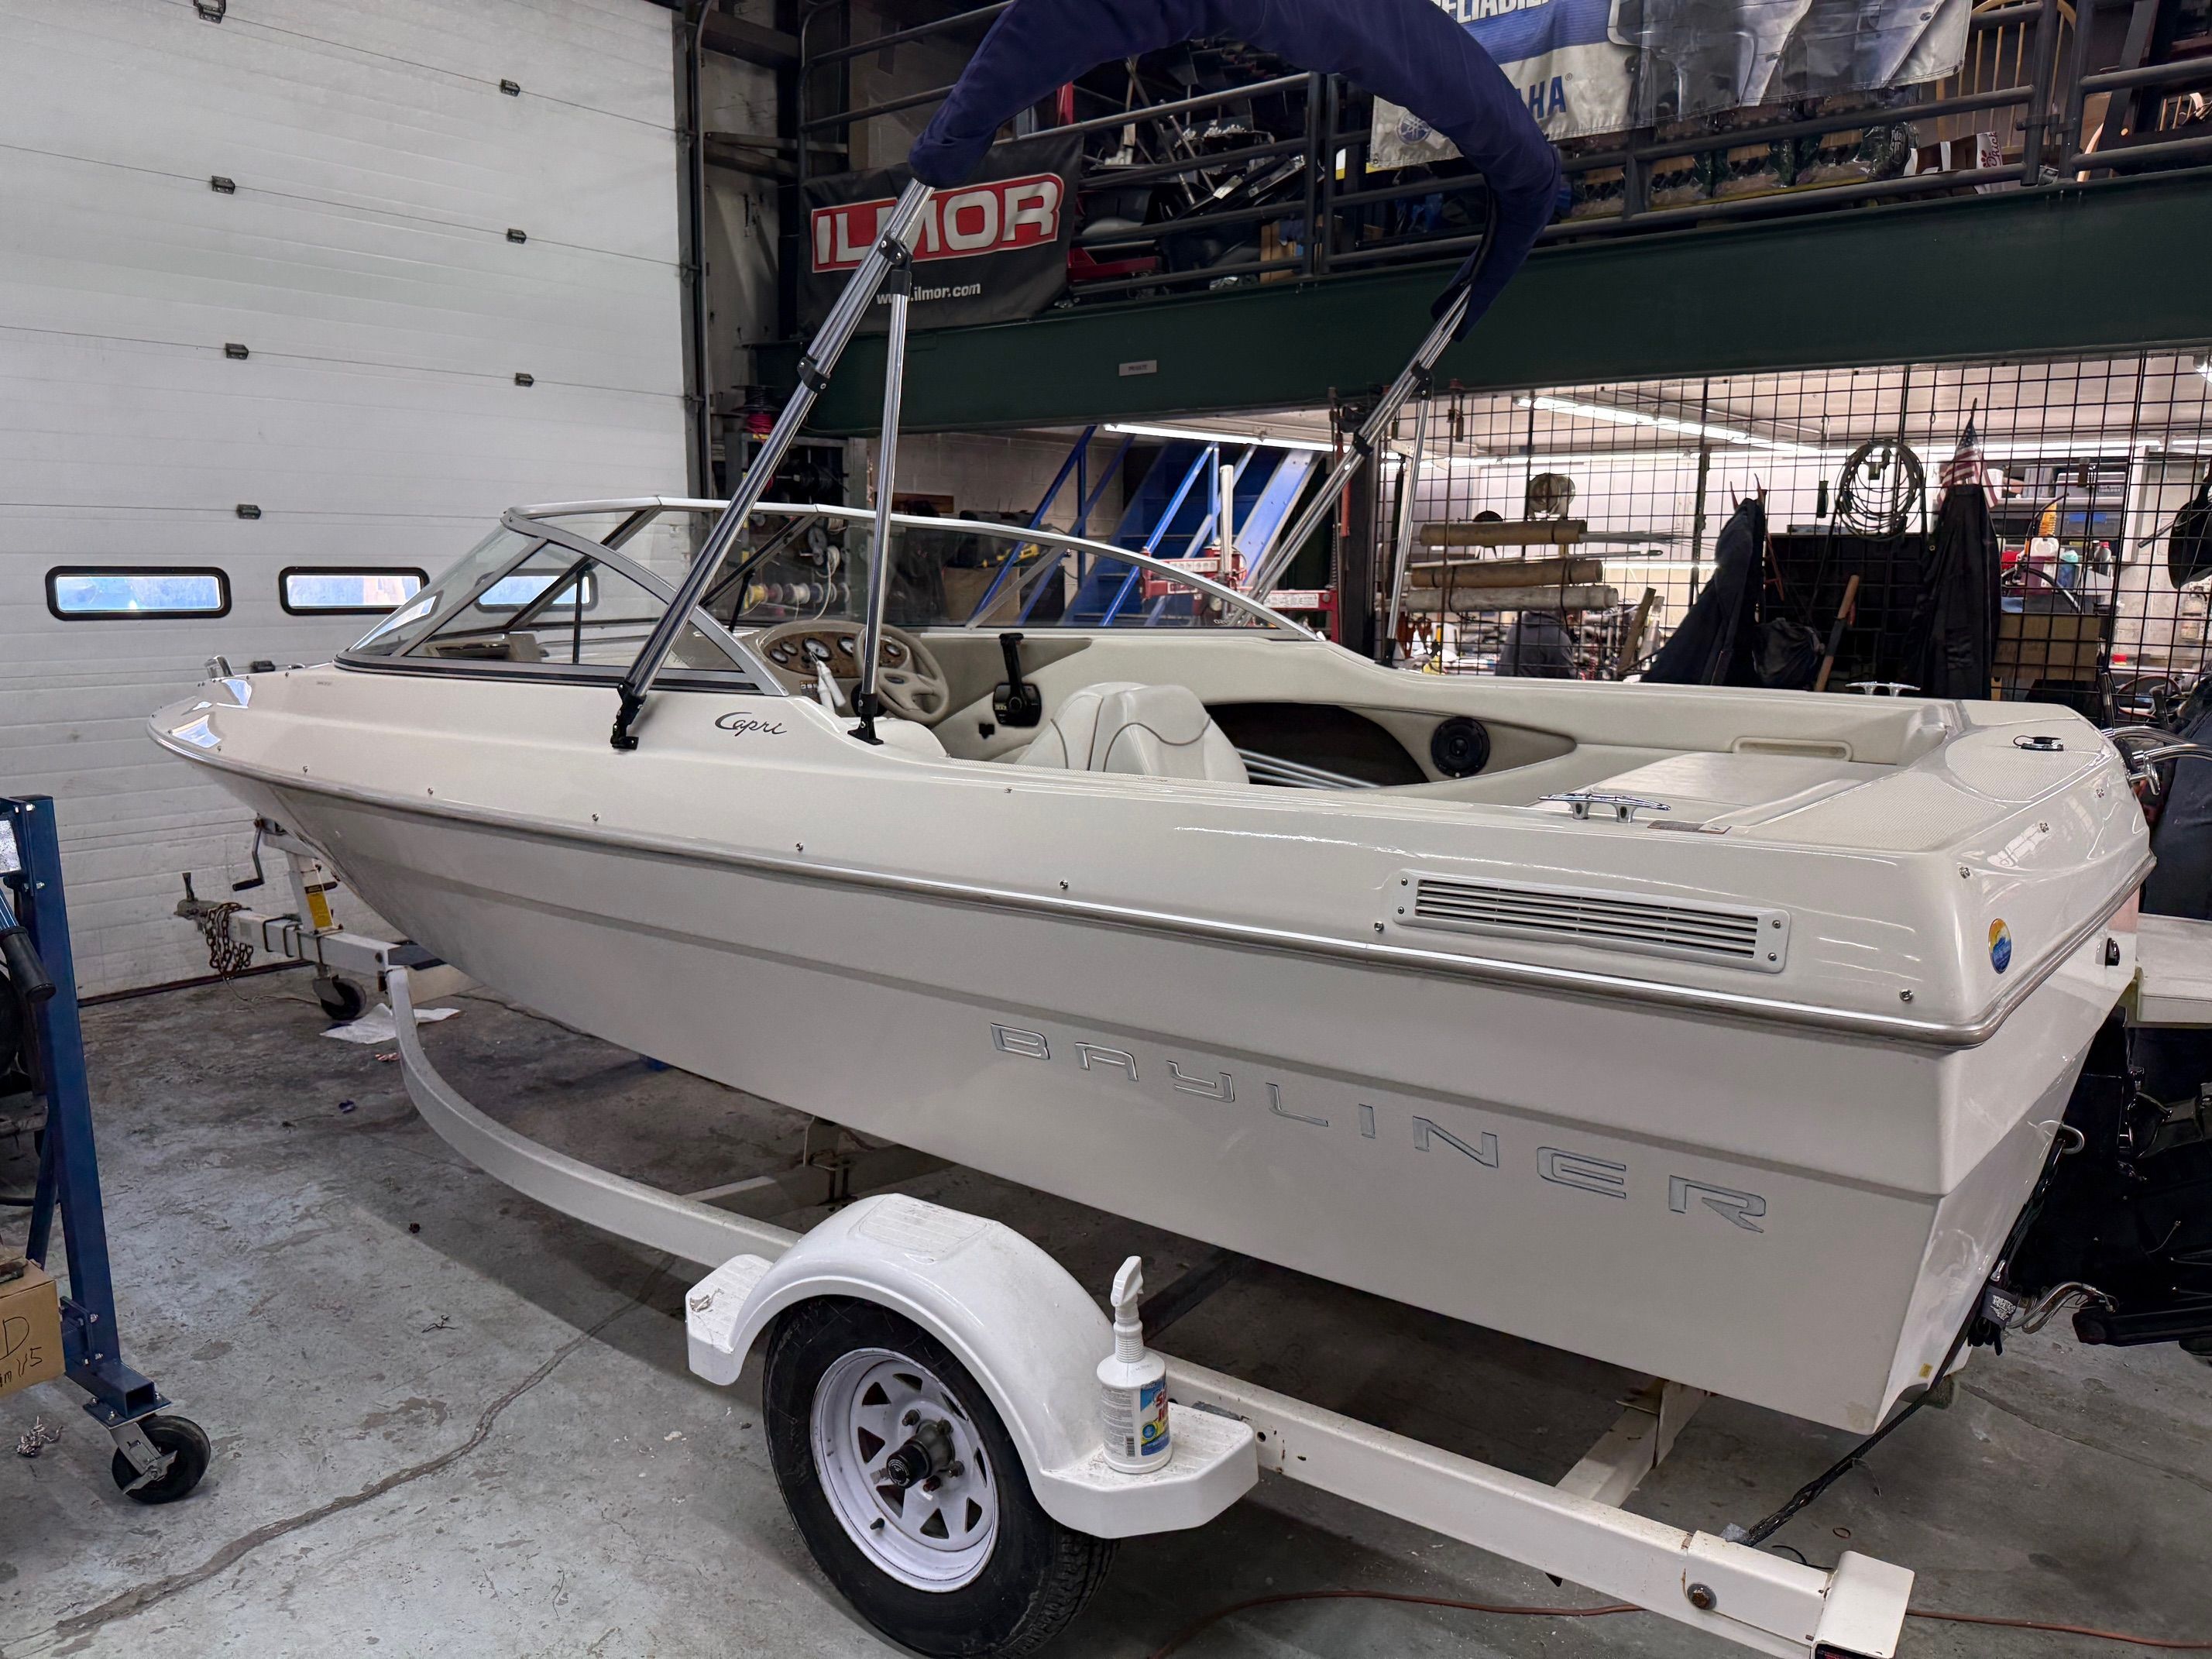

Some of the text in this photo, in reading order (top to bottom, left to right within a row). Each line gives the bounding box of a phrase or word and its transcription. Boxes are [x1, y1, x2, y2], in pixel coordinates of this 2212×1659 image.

[816, 180, 1058, 265] ILMOR
[715, 711, 787, 737] Capri
[991, 1022, 1766, 1233] BAYLINER
